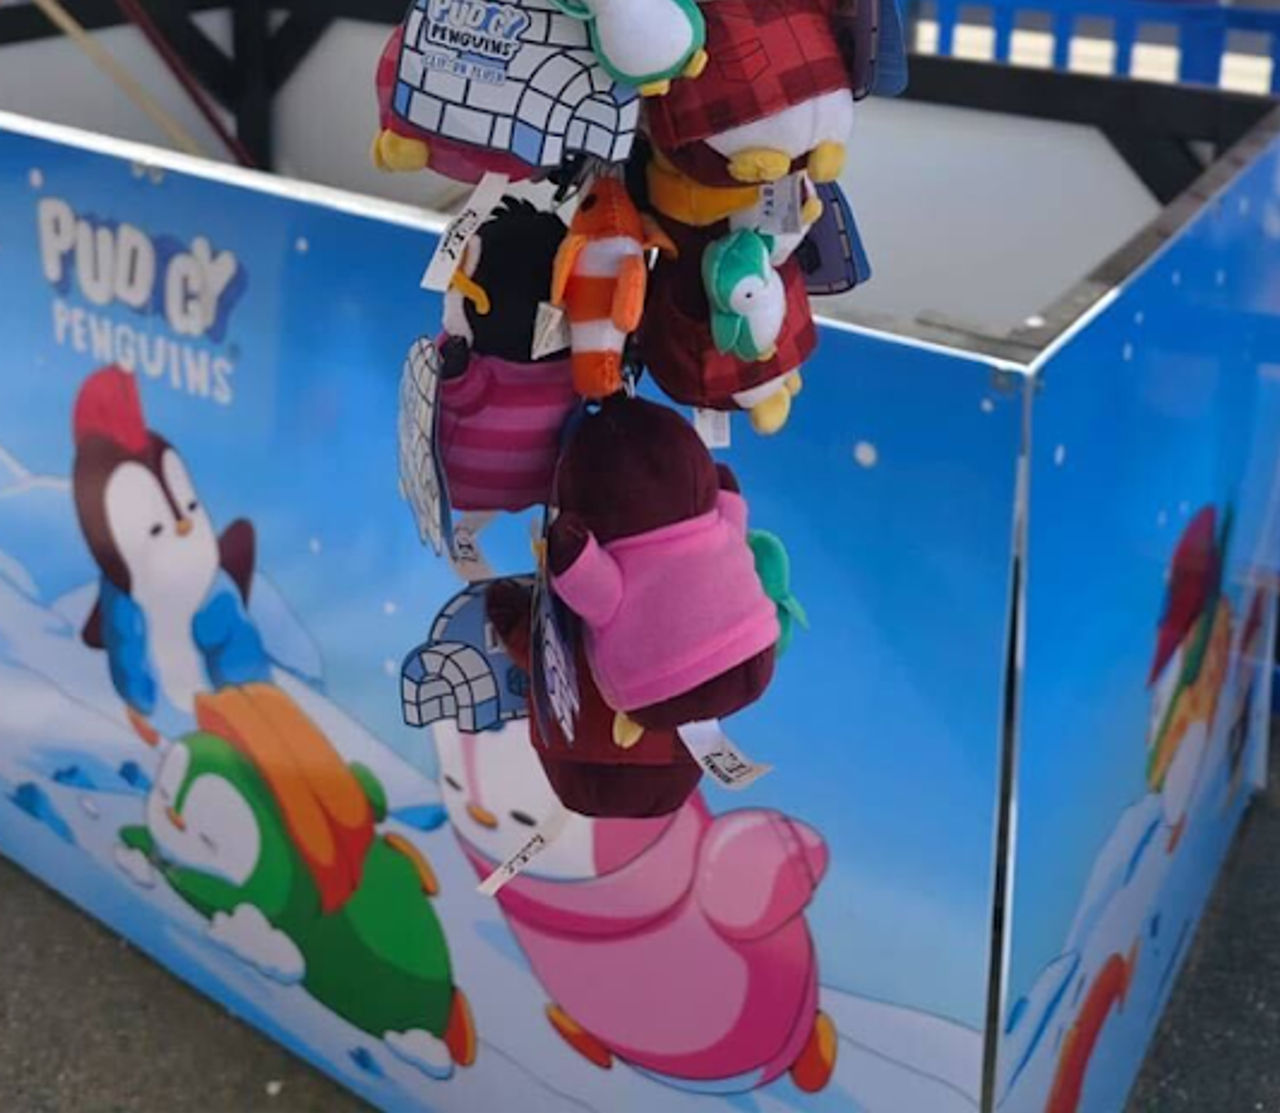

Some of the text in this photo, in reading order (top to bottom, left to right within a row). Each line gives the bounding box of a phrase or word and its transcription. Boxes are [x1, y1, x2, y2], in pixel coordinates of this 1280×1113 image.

[431, 24, 513, 57] PENGUINS
[37, 196, 245, 341] PUDGY
[54, 298, 234, 406] PENGUINS
